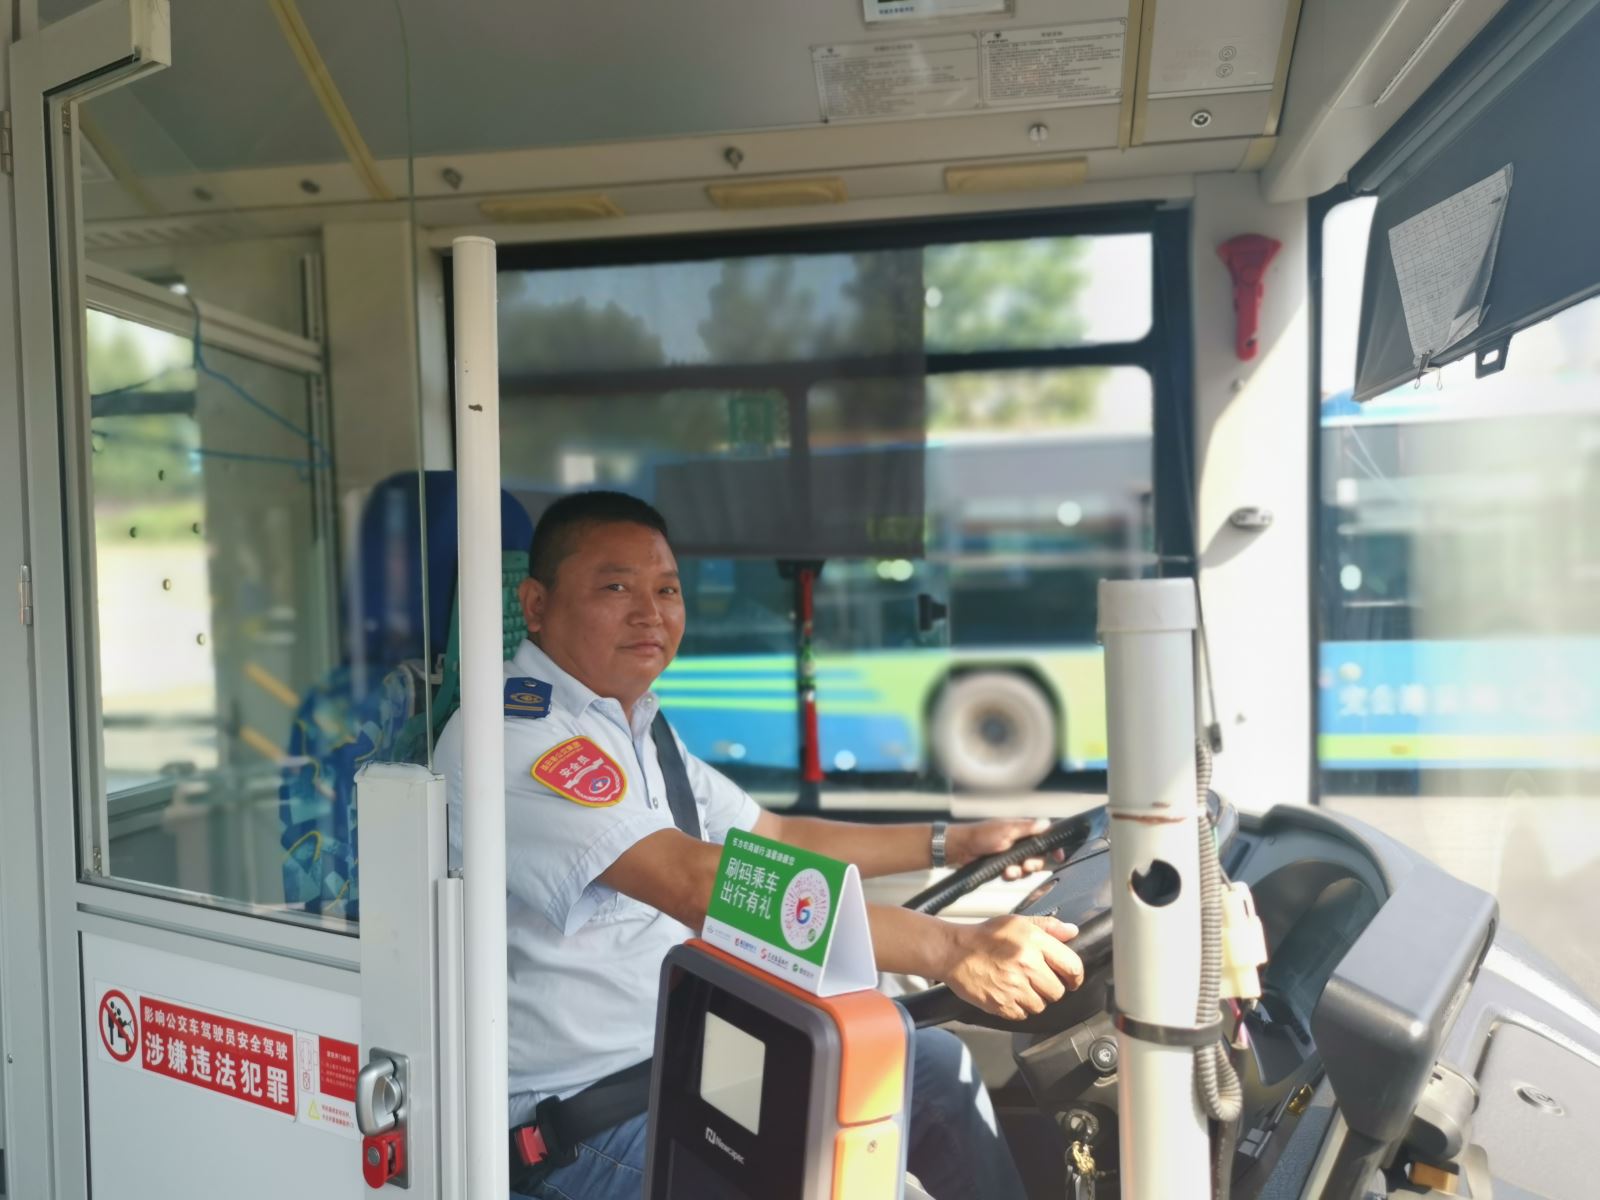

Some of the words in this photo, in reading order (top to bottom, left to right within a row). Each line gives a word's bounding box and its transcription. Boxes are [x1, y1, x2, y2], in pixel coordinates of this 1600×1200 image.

[726, 857, 780, 894] 刷码乘车
[720, 880, 772, 920] 出行有礼
[144, 1005, 288, 1061] 影响公交车驾驶员安全驾驶
[146, 1032, 289, 1104] 涉嫌违法犯罪
